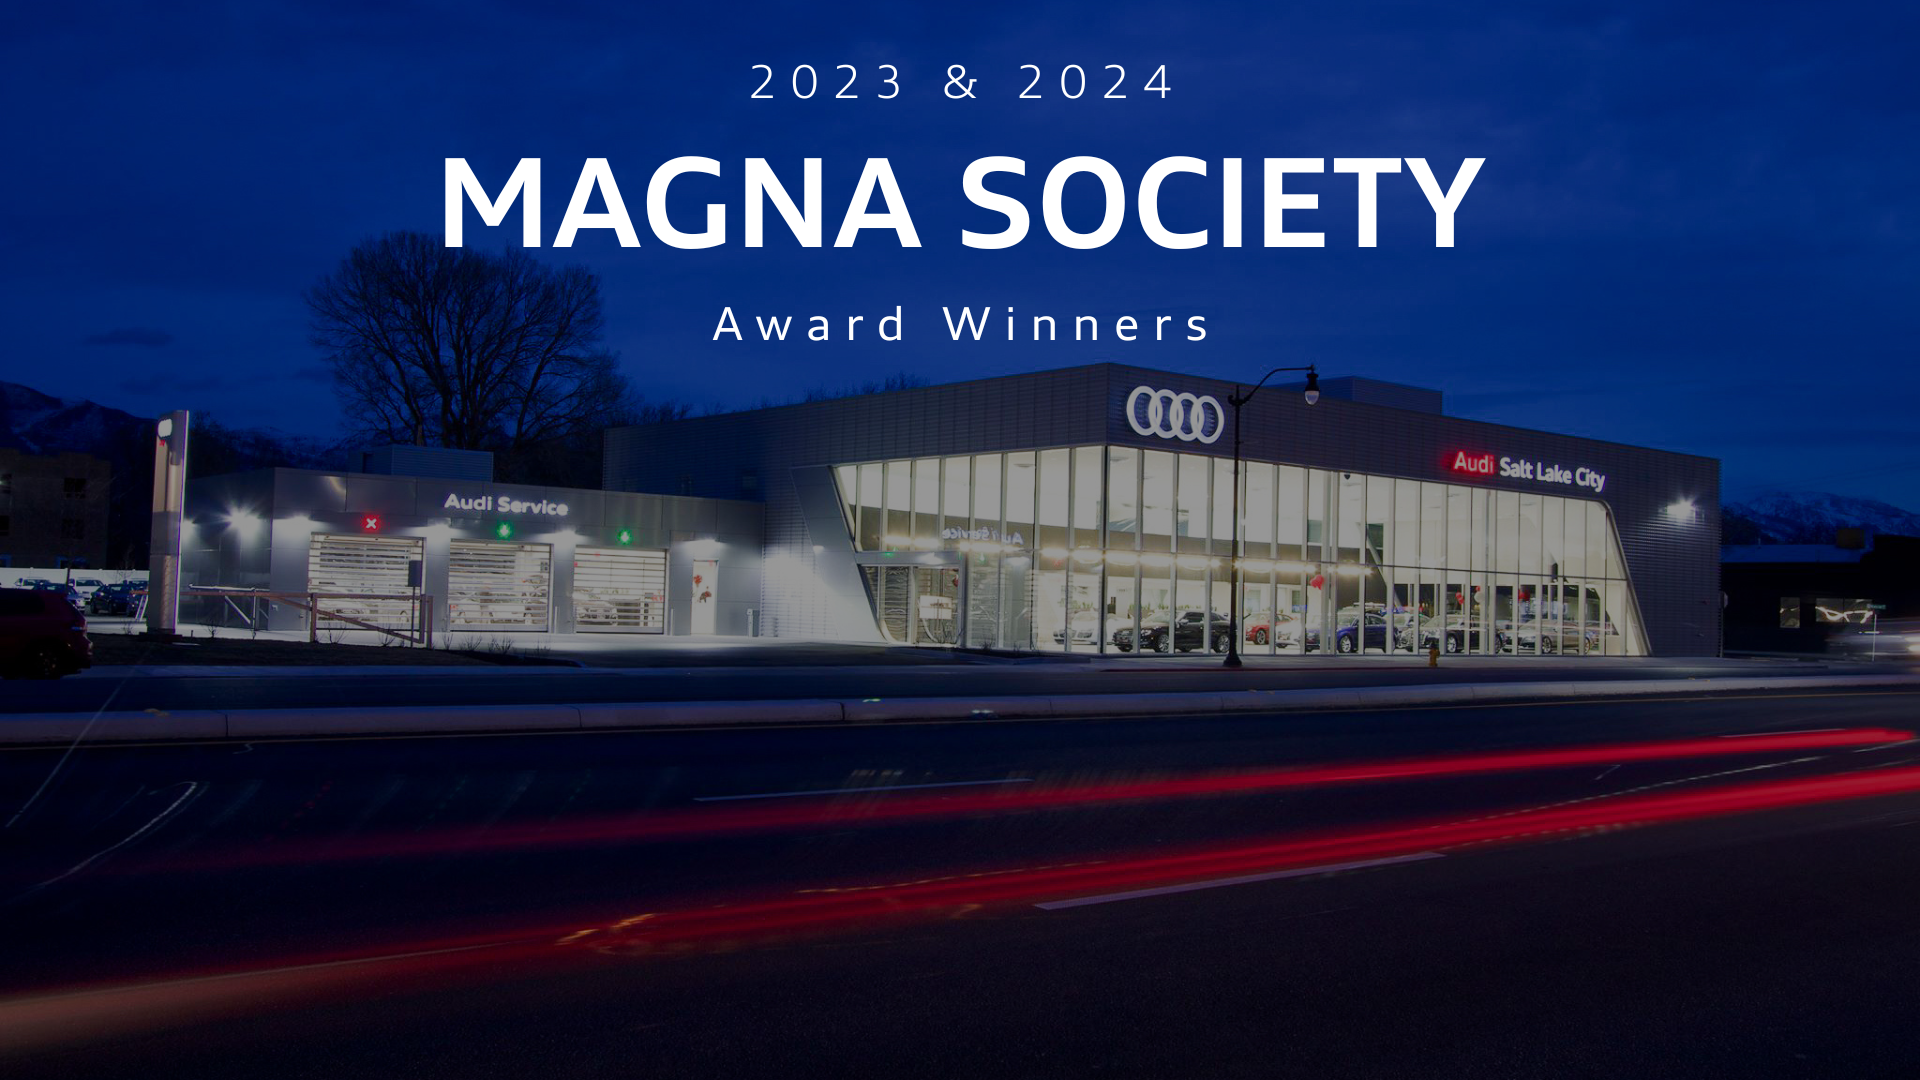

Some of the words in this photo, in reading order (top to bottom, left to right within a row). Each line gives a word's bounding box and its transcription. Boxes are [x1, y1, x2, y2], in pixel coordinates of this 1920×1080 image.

[1453, 451, 1495, 474] Audi
[1499, 456, 1534, 480] Salt
[1536, 462, 1572, 484] Lake
[1575, 467, 1606, 493] City
[444, 493, 493, 511] Audi
[497, 496, 569, 516] Service
